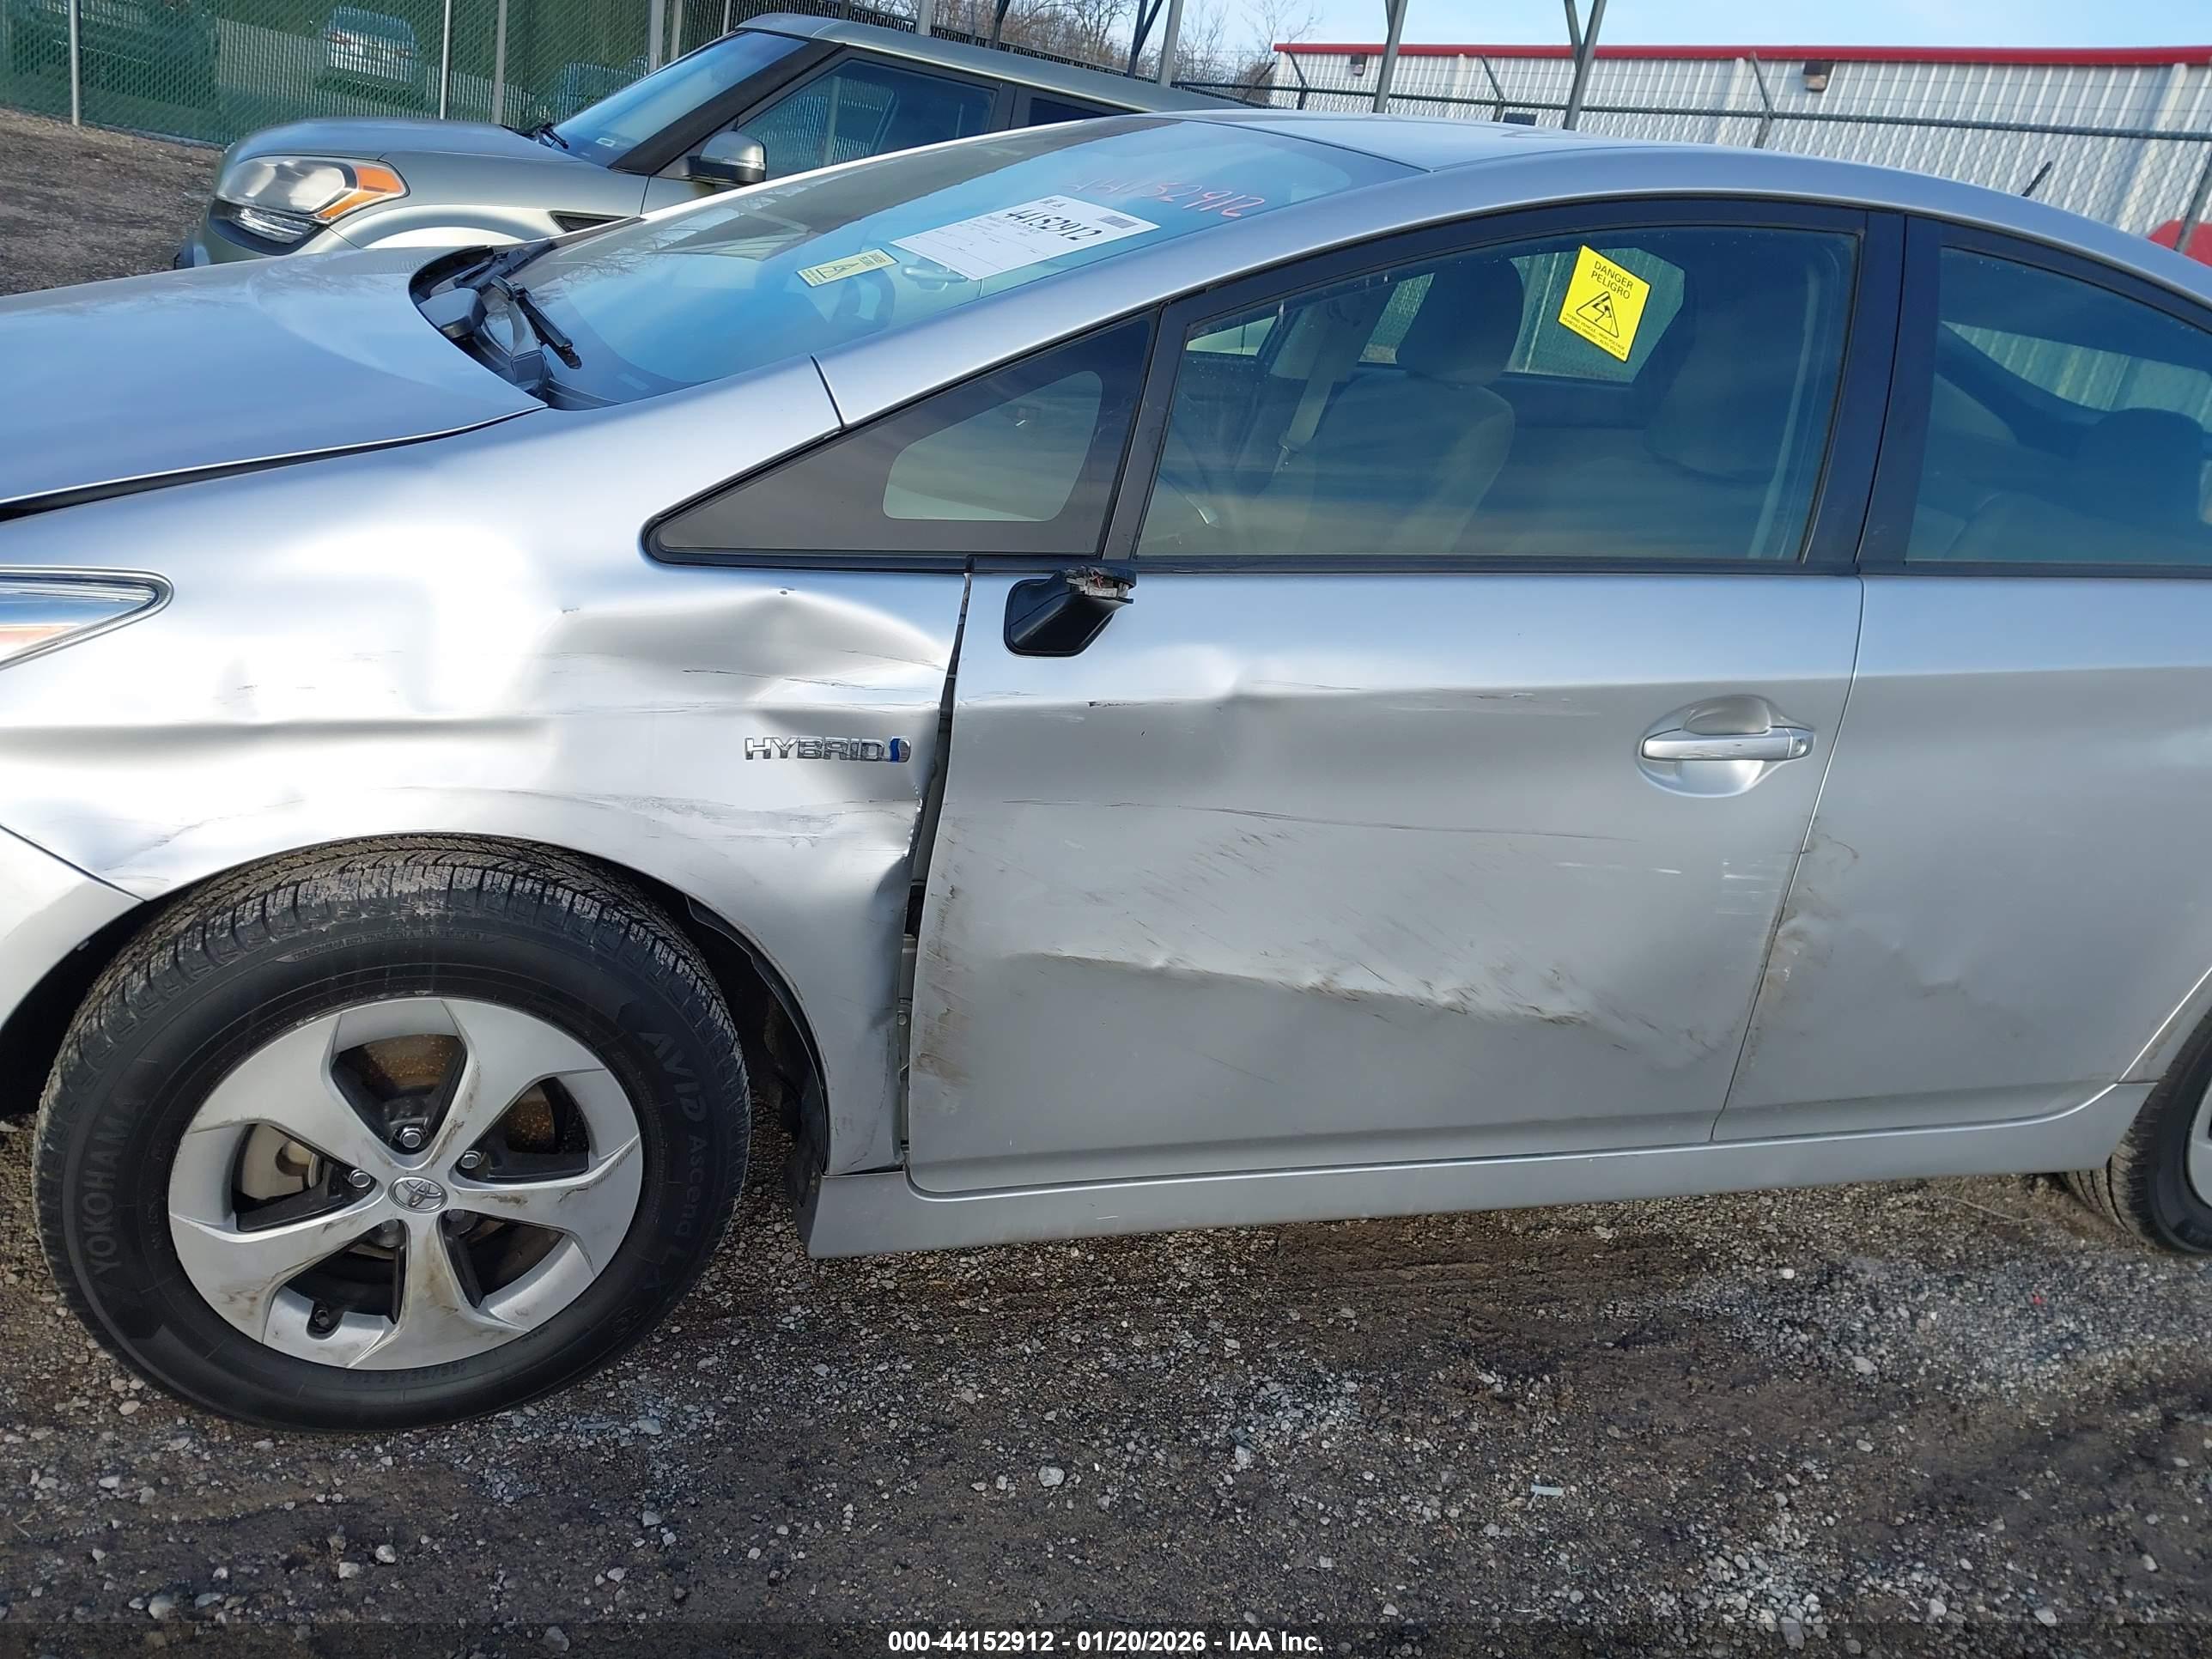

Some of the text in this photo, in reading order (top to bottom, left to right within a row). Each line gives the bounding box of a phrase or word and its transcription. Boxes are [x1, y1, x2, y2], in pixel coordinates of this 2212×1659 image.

[1004, 209, 1103, 240] 44152912
[1591, 270, 1631, 300] PELIGRO
[1594, 260, 1634, 290] DANGER
[744, 735, 885, 763] HYBRID
[638, 1031, 708, 1122] AVID
[82, 1097, 146, 1276] YOKOHAMA
